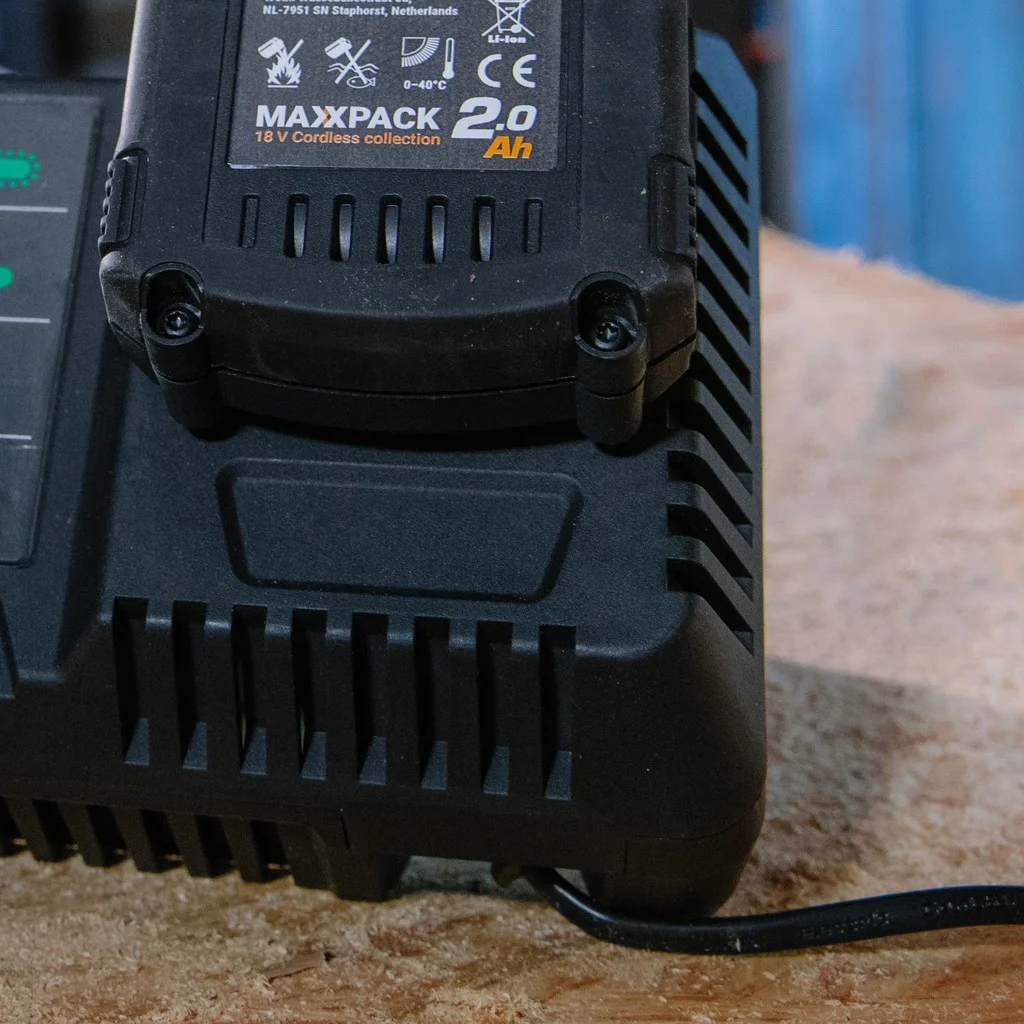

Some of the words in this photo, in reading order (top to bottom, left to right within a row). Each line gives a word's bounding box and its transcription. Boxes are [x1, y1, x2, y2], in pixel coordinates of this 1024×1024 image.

[262, 5, 310, 16] NL-7951
[312, 5, 330, 16] SN
[331, 6, 389, 18] Staphorst,
[391, 6, 460, 17] Netherlands
[255, 105, 442, 130] MAXXPACK
[451, 97, 538, 139] 2.0
[255, 131, 274, 144] 18
[275, 131, 288, 144] V
[291, 132, 360, 145] Cordless
[363, 133, 442, 146] collection
[483, 135, 533, 159] Ah
